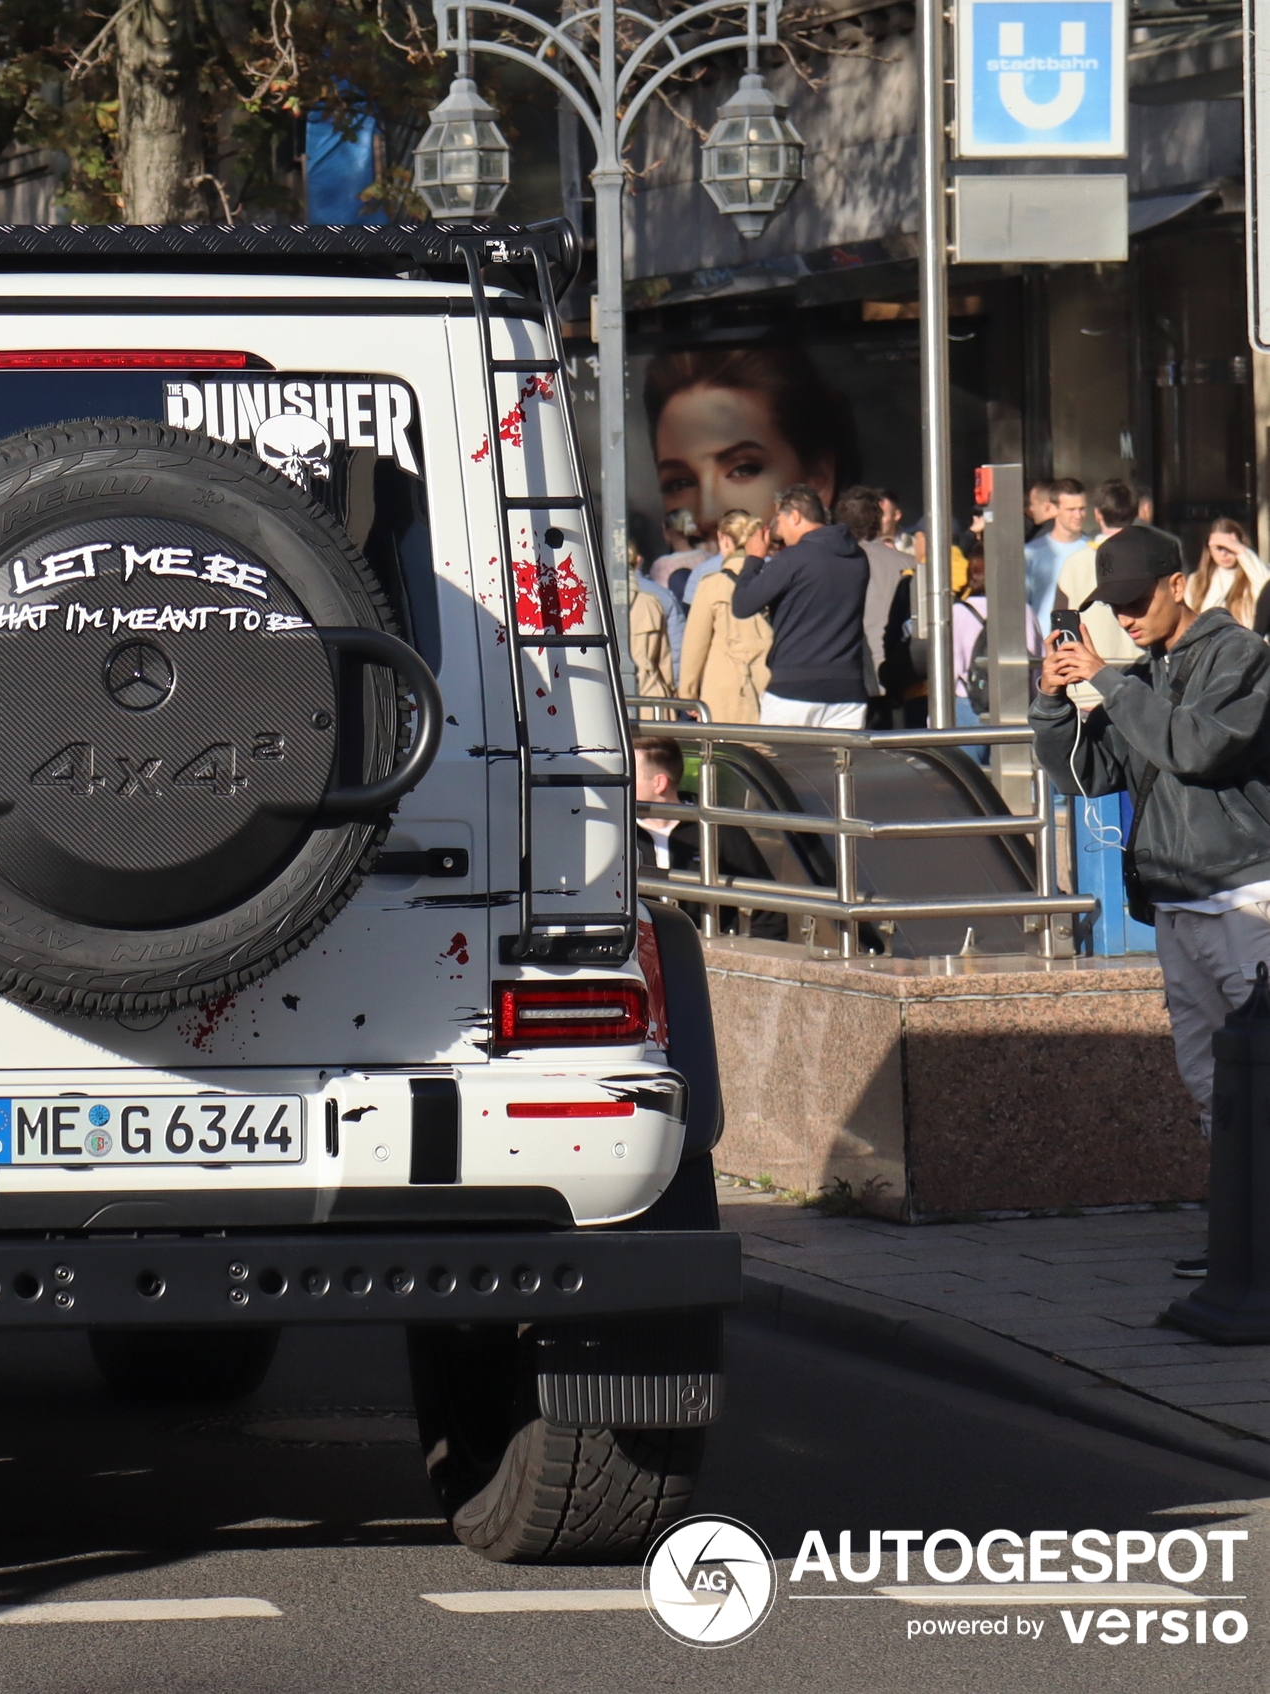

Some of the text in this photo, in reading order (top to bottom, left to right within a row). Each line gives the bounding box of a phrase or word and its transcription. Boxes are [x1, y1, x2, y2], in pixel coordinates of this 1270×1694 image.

[987, 56, 1099, 72] stadtbahn
[999, 22, 1086, 130] U
[167, 384, 183, 396] THE
[167, 382, 420, 476] PUNISHER
[11, 543, 269, 599] LET ME BE
[66, 602, 105, 633] I'M
[112, 605, 219, 634] MEANT
[224, 606, 261, 632] TO
[265, 613, 313, 631] BE
[112, 830, 335, 963] SCORPION
[16, 1104, 292, 1156] ME G 6344
